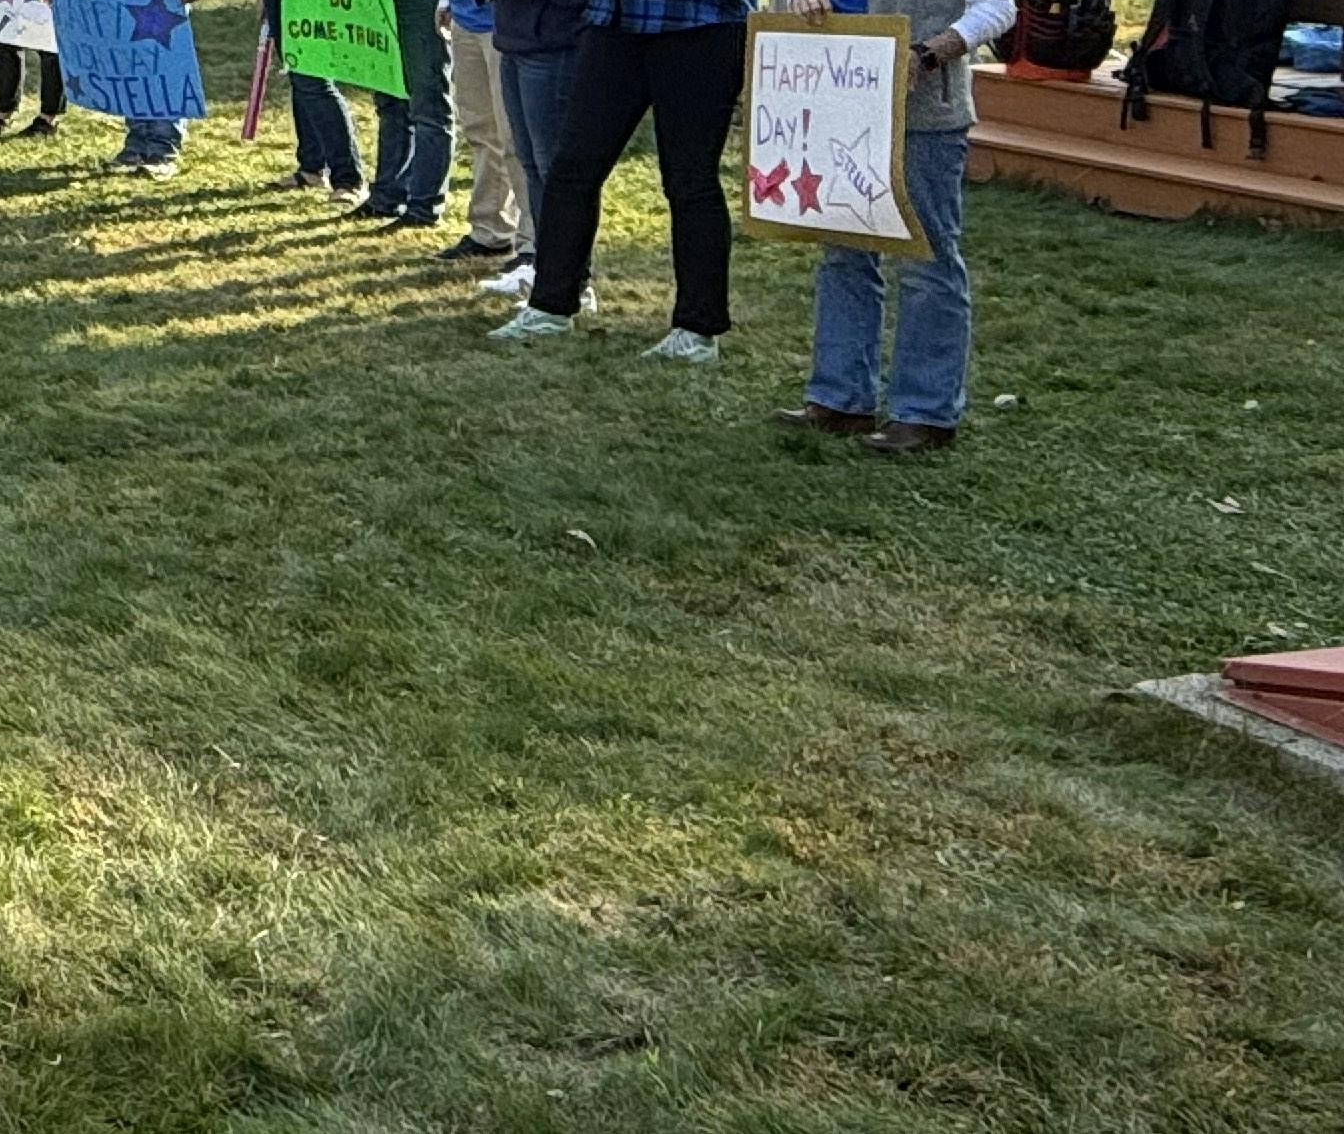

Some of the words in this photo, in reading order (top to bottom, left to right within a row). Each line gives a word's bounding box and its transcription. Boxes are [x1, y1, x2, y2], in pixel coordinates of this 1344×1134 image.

[288, 19, 338, 41] COME
[345, 23, 389, 54] TRUE!
[759, 42, 824, 94] HAPPY
[825, 45, 880, 90] WISH
[89, 73, 206, 117] STELLA
